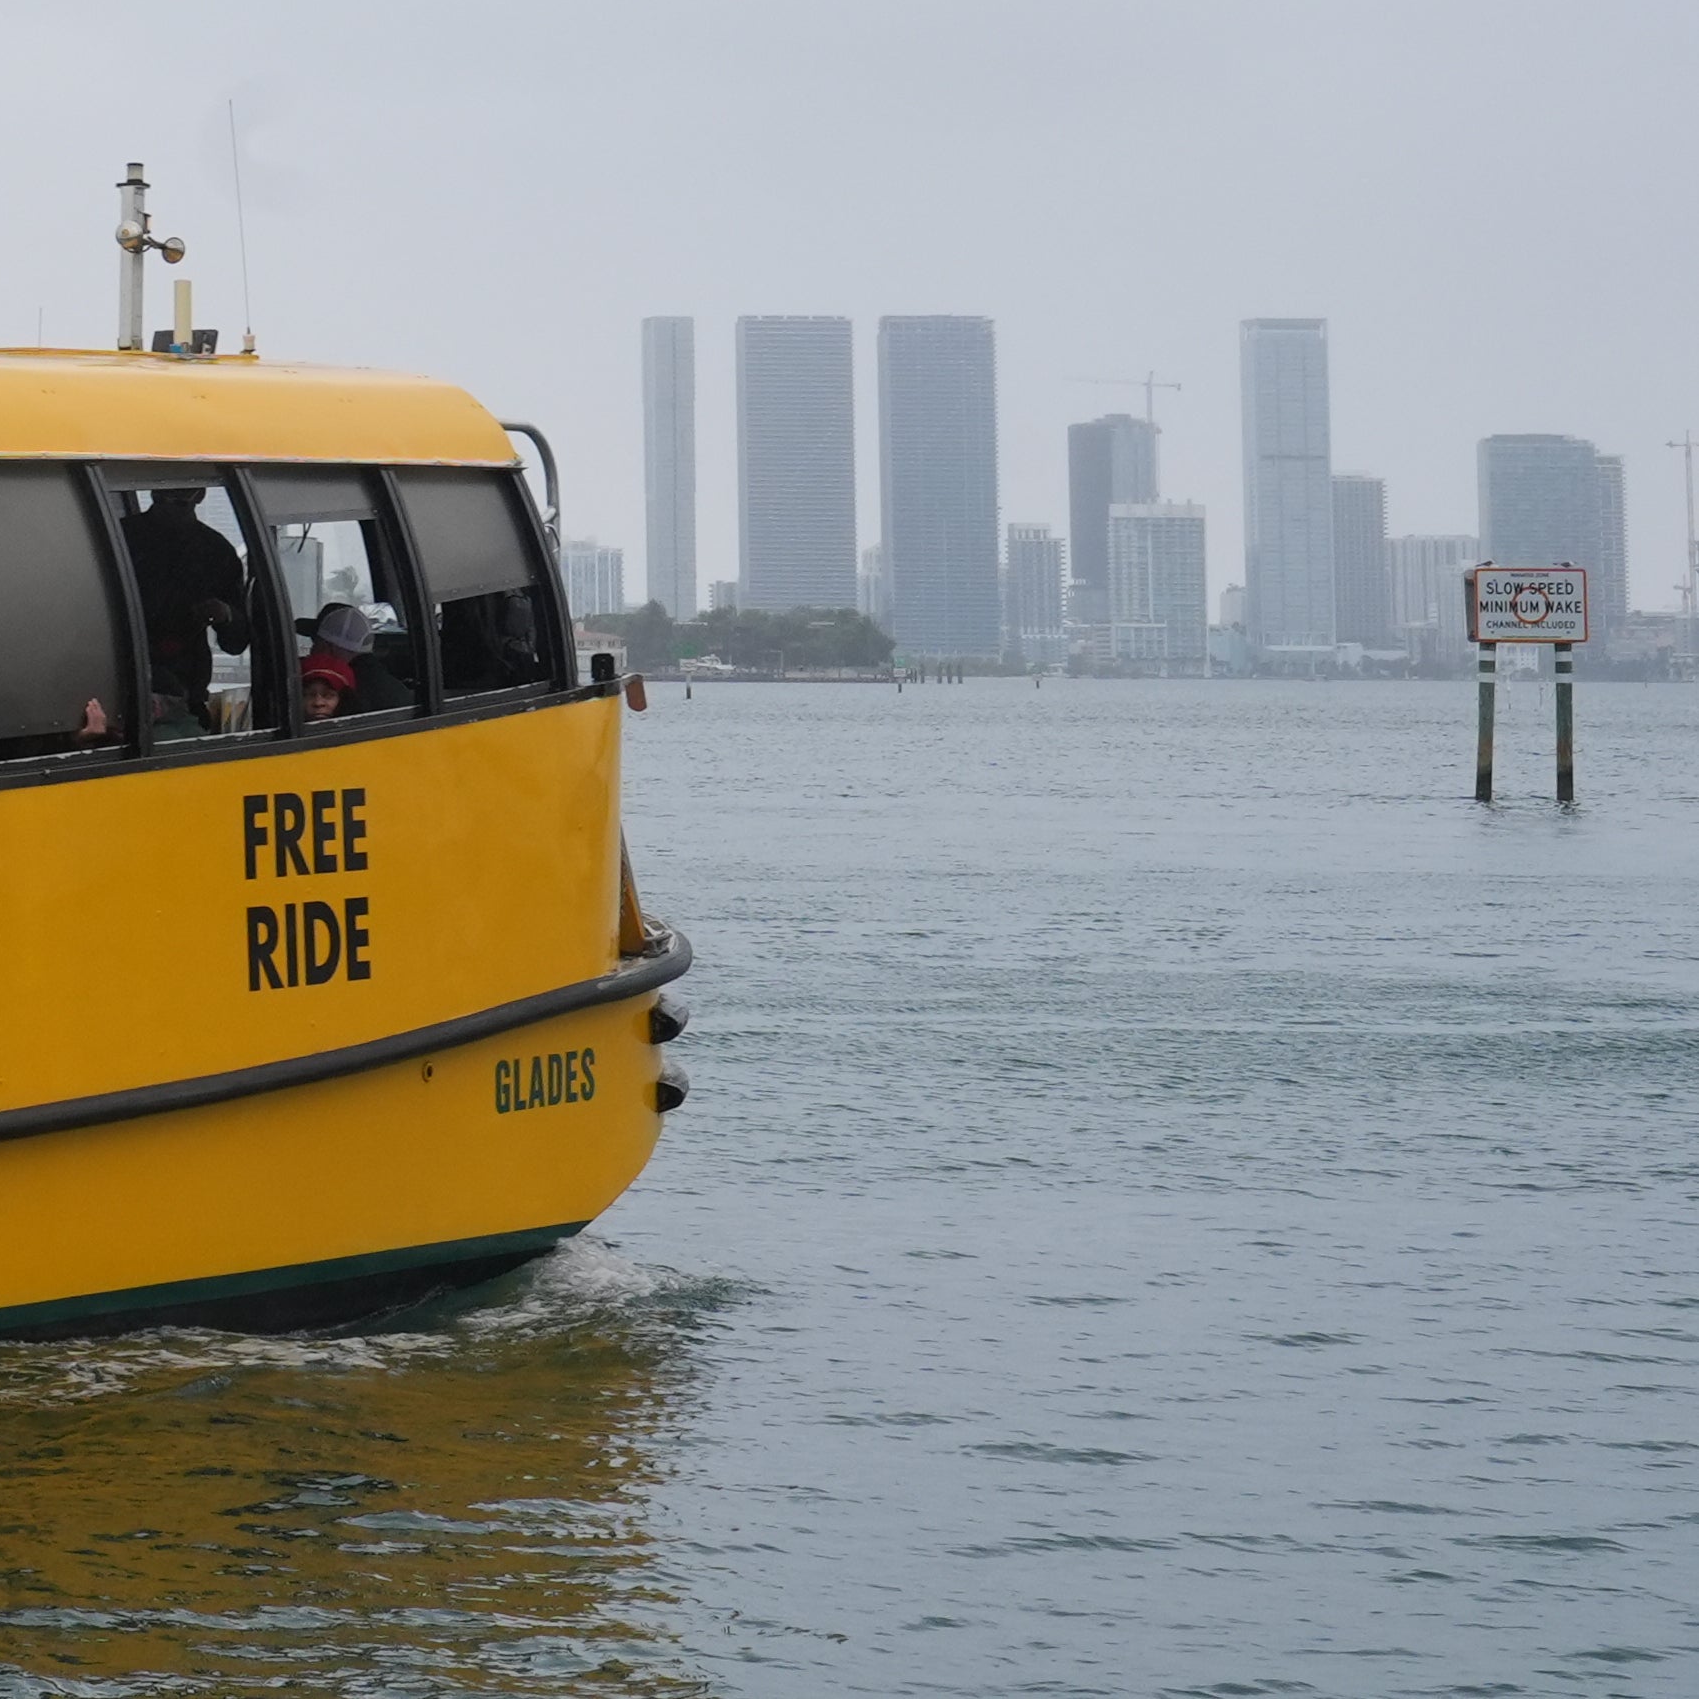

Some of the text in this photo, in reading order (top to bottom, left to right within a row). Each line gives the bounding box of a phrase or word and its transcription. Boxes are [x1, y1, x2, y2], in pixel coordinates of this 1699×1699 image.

[1479, 601, 1582, 614] MINIMUM WAKE
[1486, 582, 1574, 595] SLOW SPEED
[1486, 621, 1530, 629] CHANNEL
[243, 788, 368, 879] FREE
[247, 897, 370, 991] RIDE
[495, 1048, 595, 1114] GLADES
